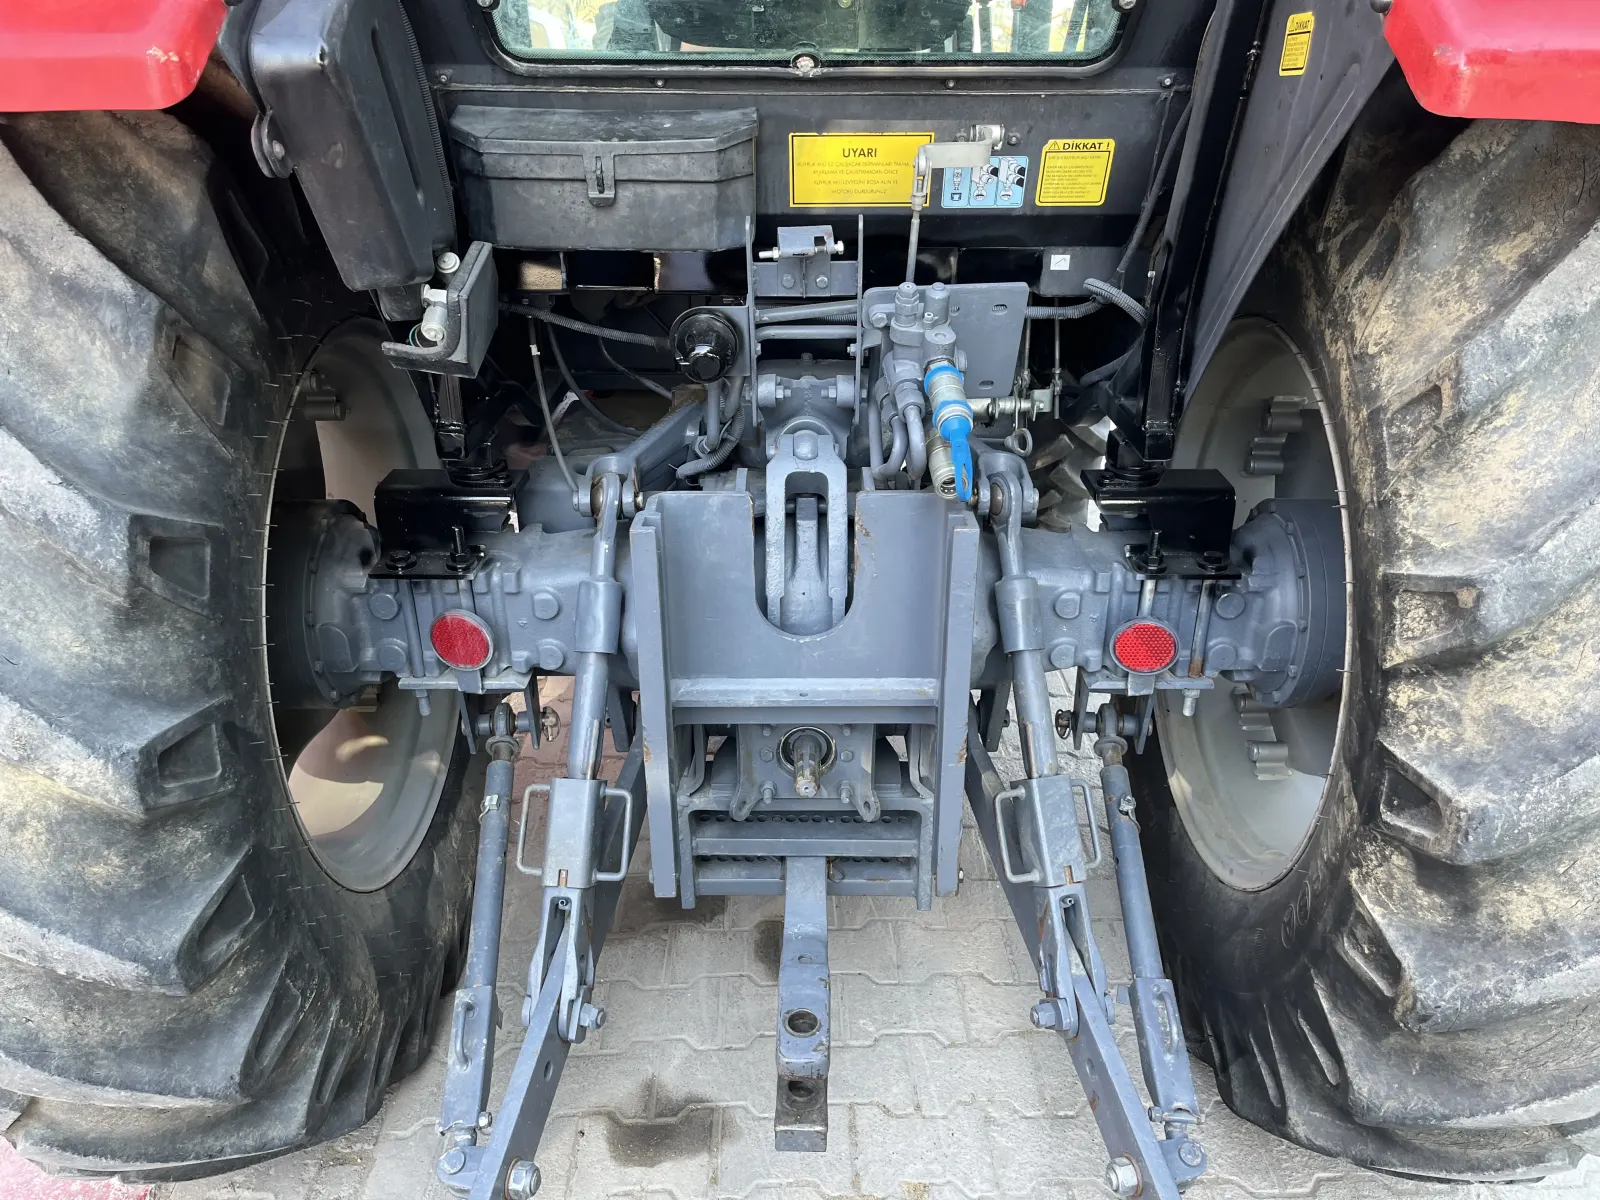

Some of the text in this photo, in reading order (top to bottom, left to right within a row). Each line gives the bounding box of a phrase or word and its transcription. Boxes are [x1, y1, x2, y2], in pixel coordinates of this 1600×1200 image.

[1062, 140, 1110, 151] DİKKAT !
[842, 148, 877, 158] UYARI
